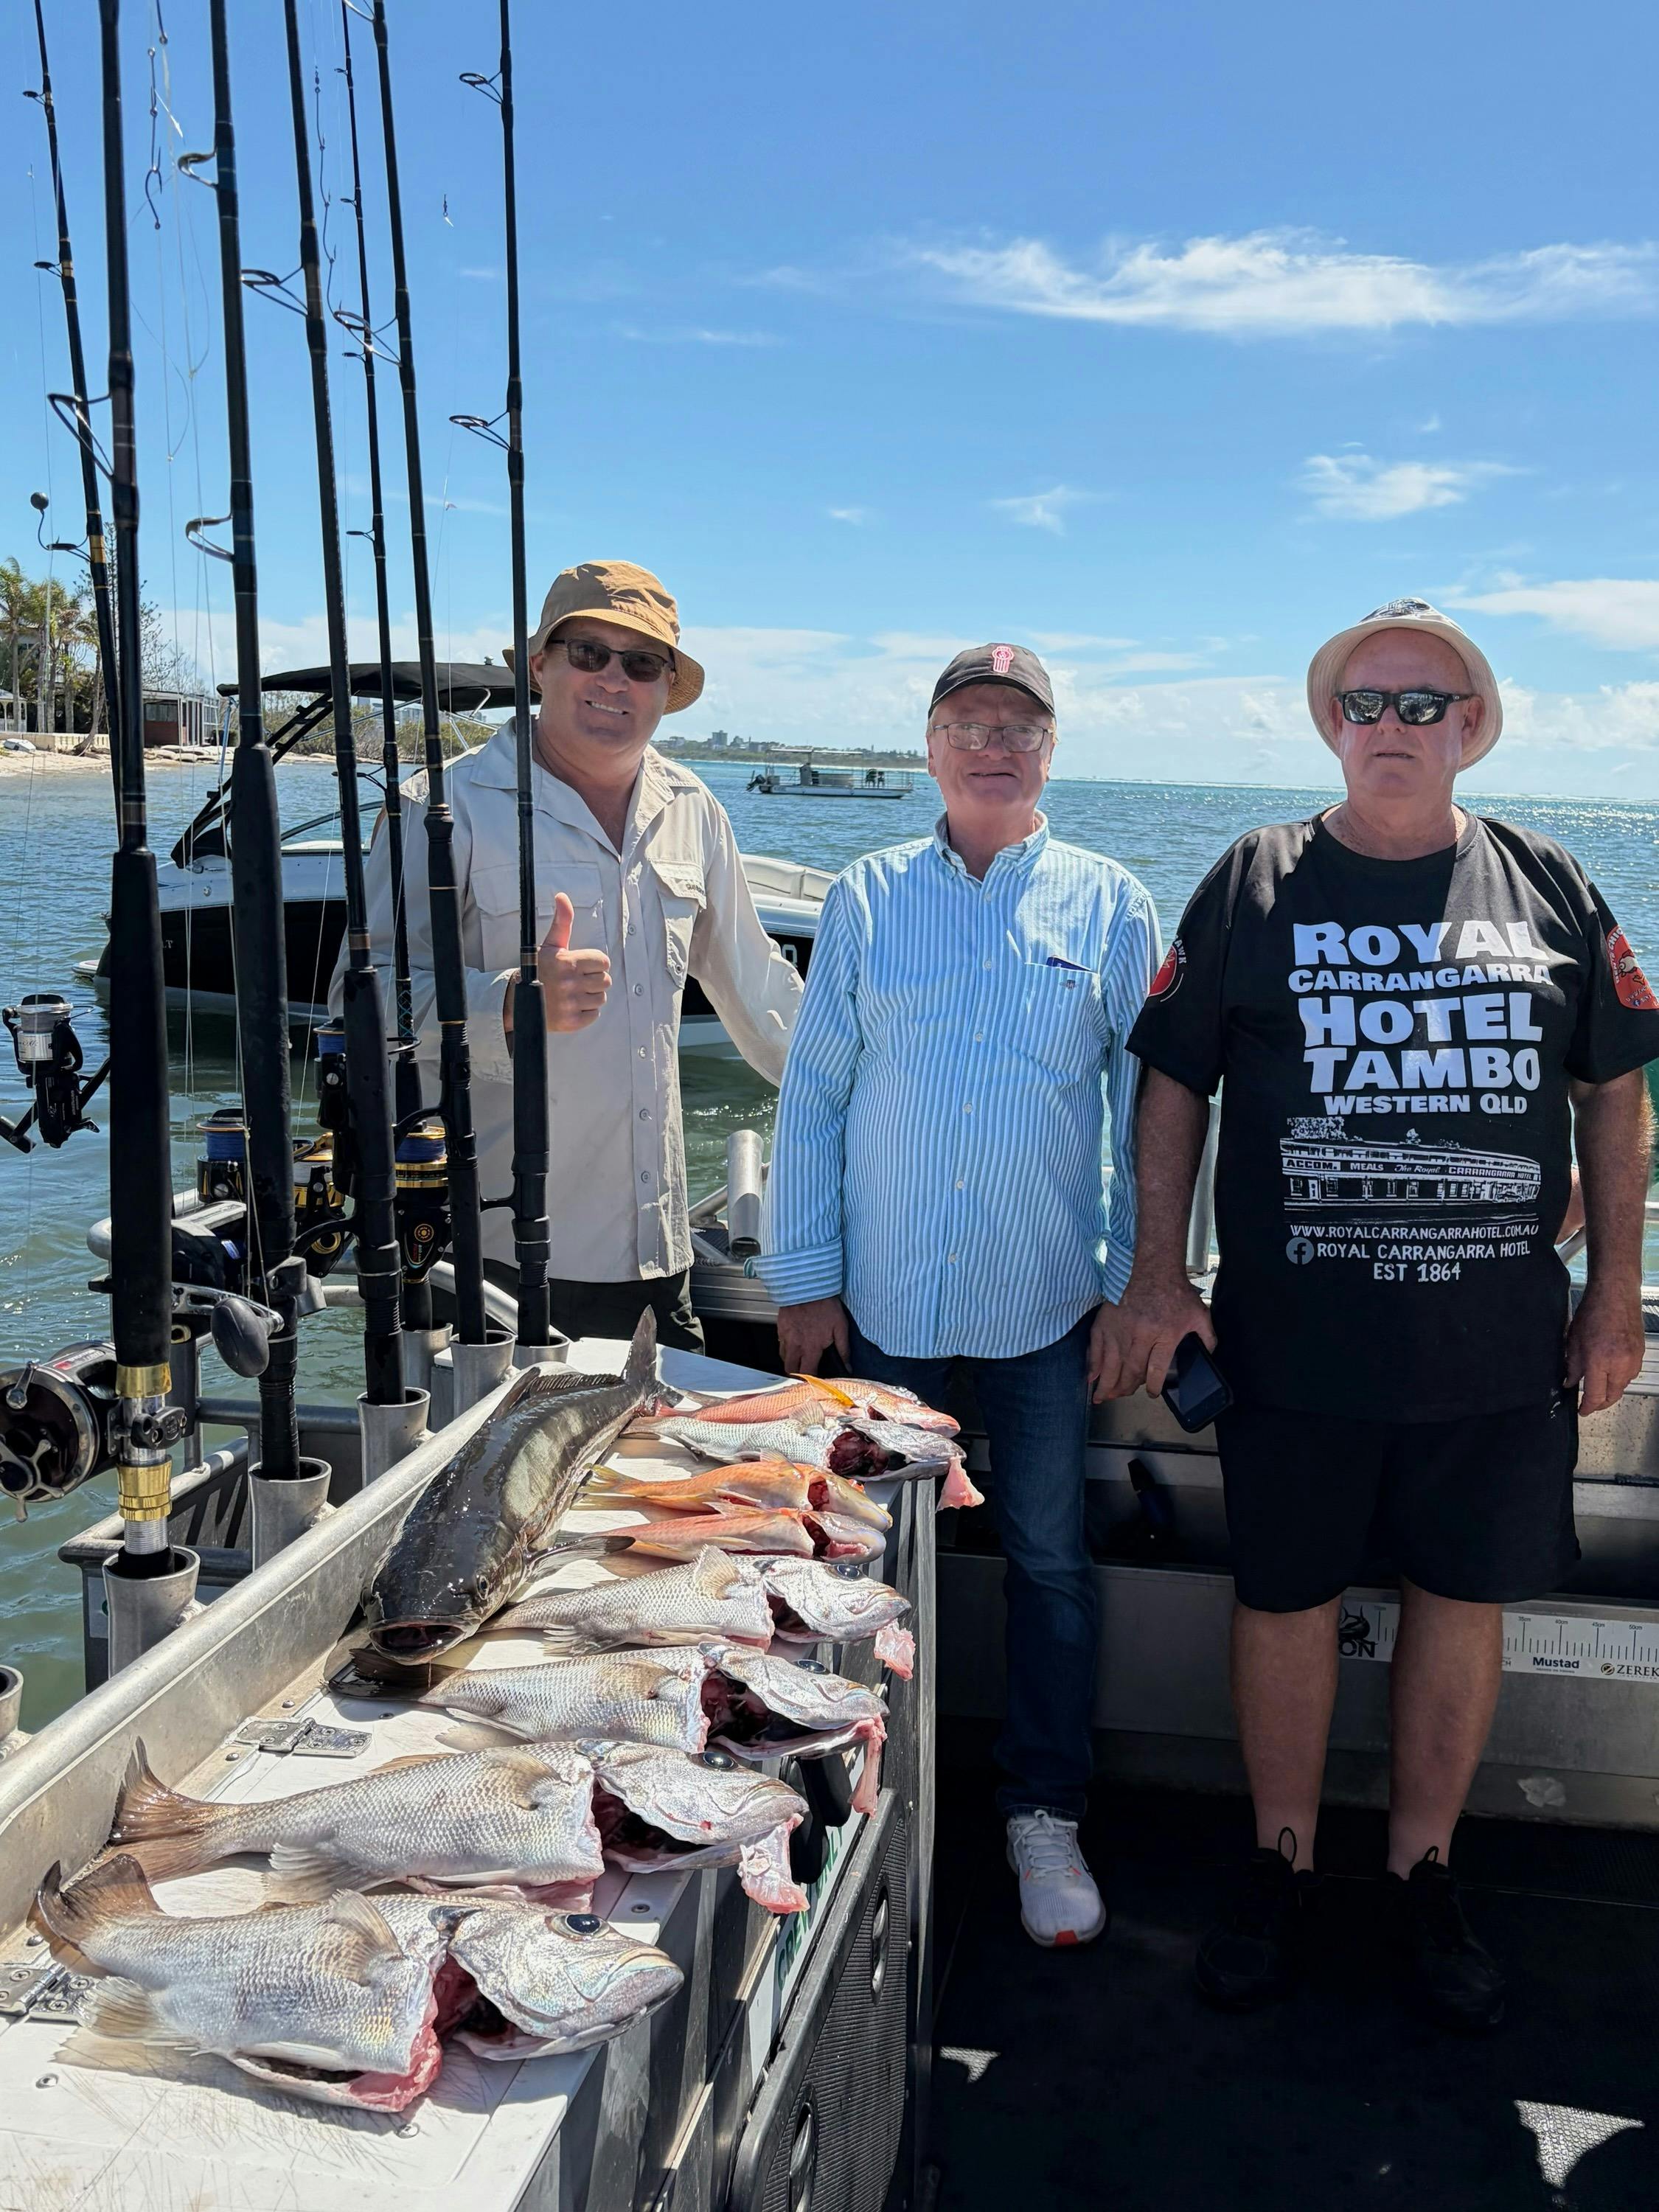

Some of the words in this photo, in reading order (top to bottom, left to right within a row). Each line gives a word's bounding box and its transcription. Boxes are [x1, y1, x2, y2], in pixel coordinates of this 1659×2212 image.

[1293, 921, 1550, 967] ROYAL
[1288, 963, 1554, 993] CARRANGARRA
[1298, 992, 1543, 1048] HOTEL
[1303, 1047, 1541, 1093] TAMBO
[1324, 1094, 1471, 1116] WESTERN
[1479, 1093, 1528, 1115] QLD
[1286, 1159, 1338, 1171] ACCOM.
[1350, 1162, 1385, 1172] MEALS
[1413, 1165, 1441, 1175] Royal
[1316, 1242, 1371, 1259] ROYAL
[1377, 1243, 1496, 1261] CARRANGARRA
[1500, 1240, 1531, 1258] HOTEL
[1373, 1262, 1408, 1282] EST
[1416, 1261, 1461, 1283] 1864
[1533, 1657, 1579, 1669] Mustad
